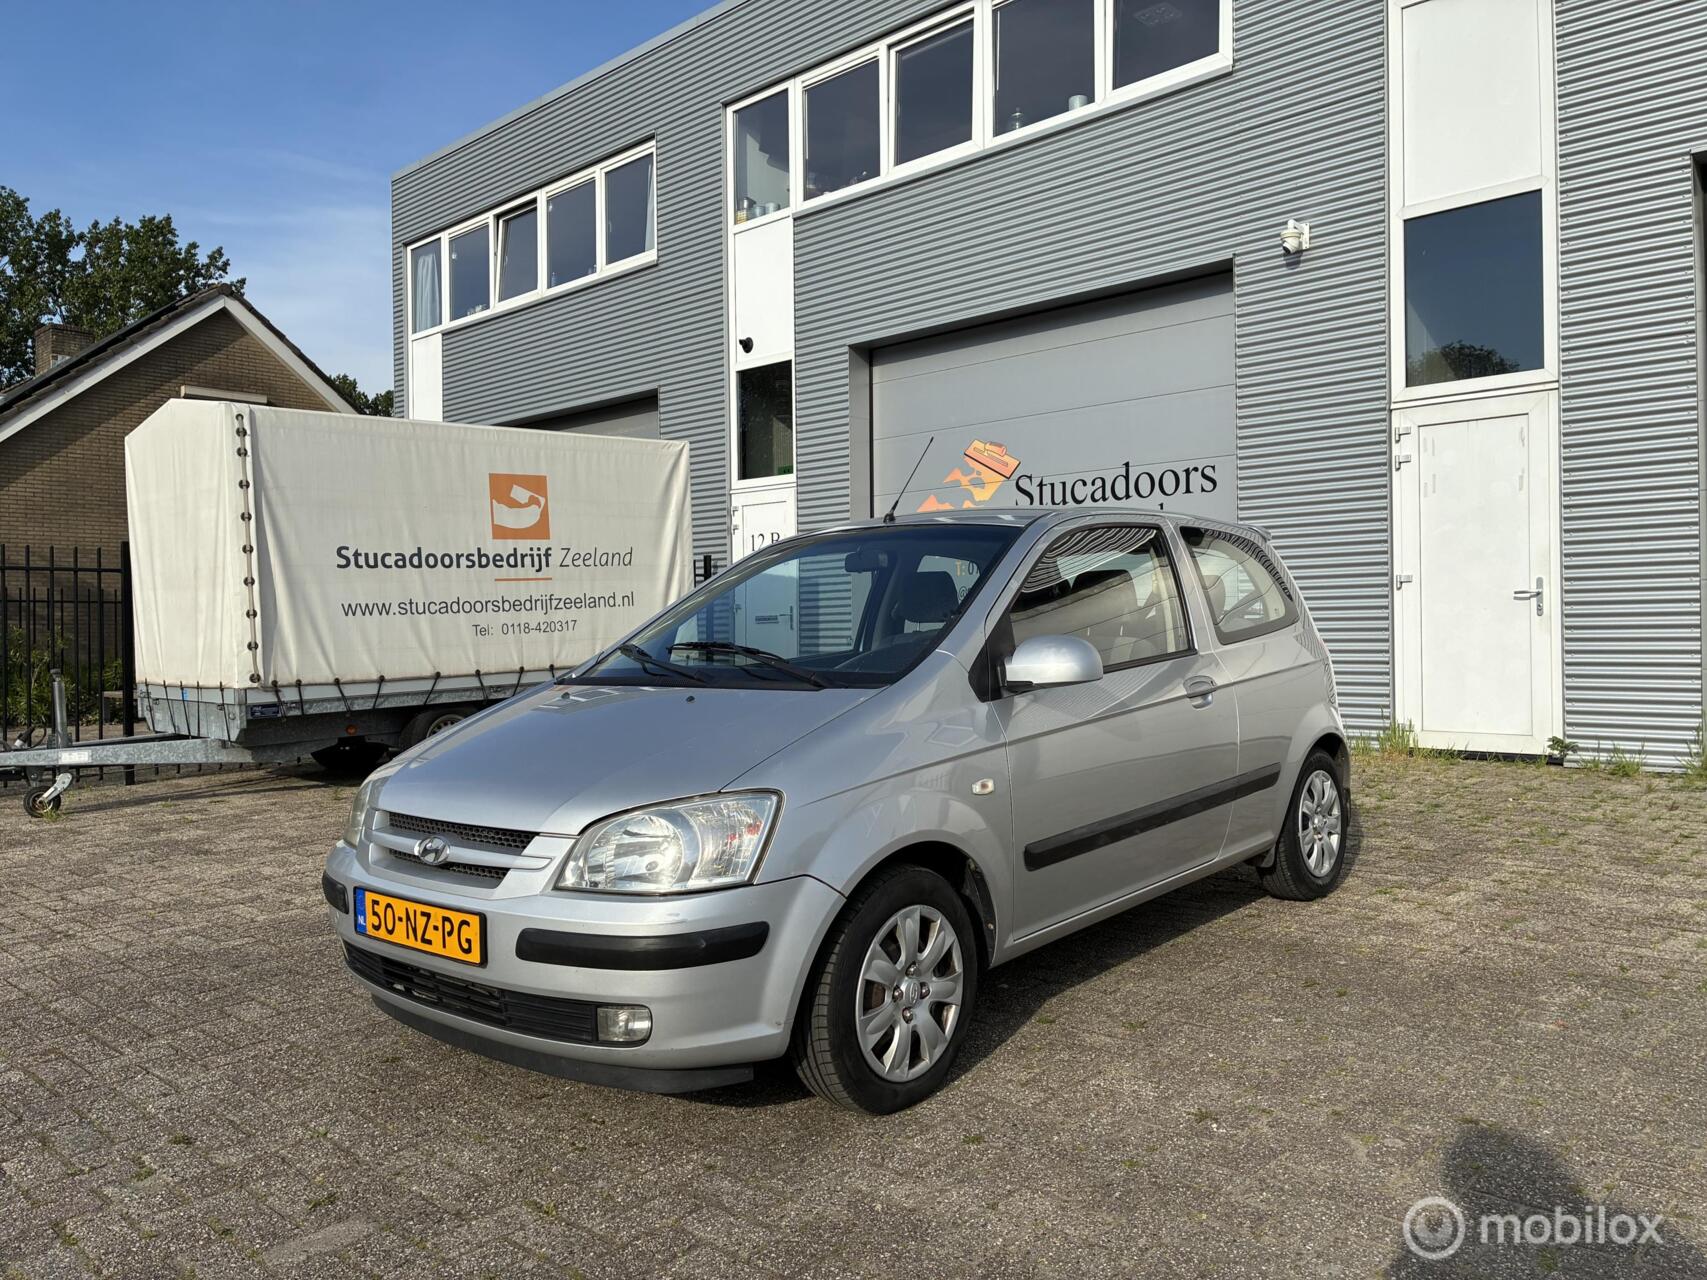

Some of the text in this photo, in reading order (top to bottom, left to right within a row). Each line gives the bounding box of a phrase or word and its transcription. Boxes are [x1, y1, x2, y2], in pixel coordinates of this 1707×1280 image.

[1015, 461, 1218, 506] Stucadoors
[751, 533, 765, 551] 12
[336, 545, 634, 571] Stucadoorsbedrijf Zeeland
[341, 591, 635, 617] www.stucadoorsbedrijfzeeland.nl
[472, 619, 578, 637] Tel: 0118-420317
[358, 914, 367, 926] NL
[371, 898, 473, 955] 50-NZ-PG
